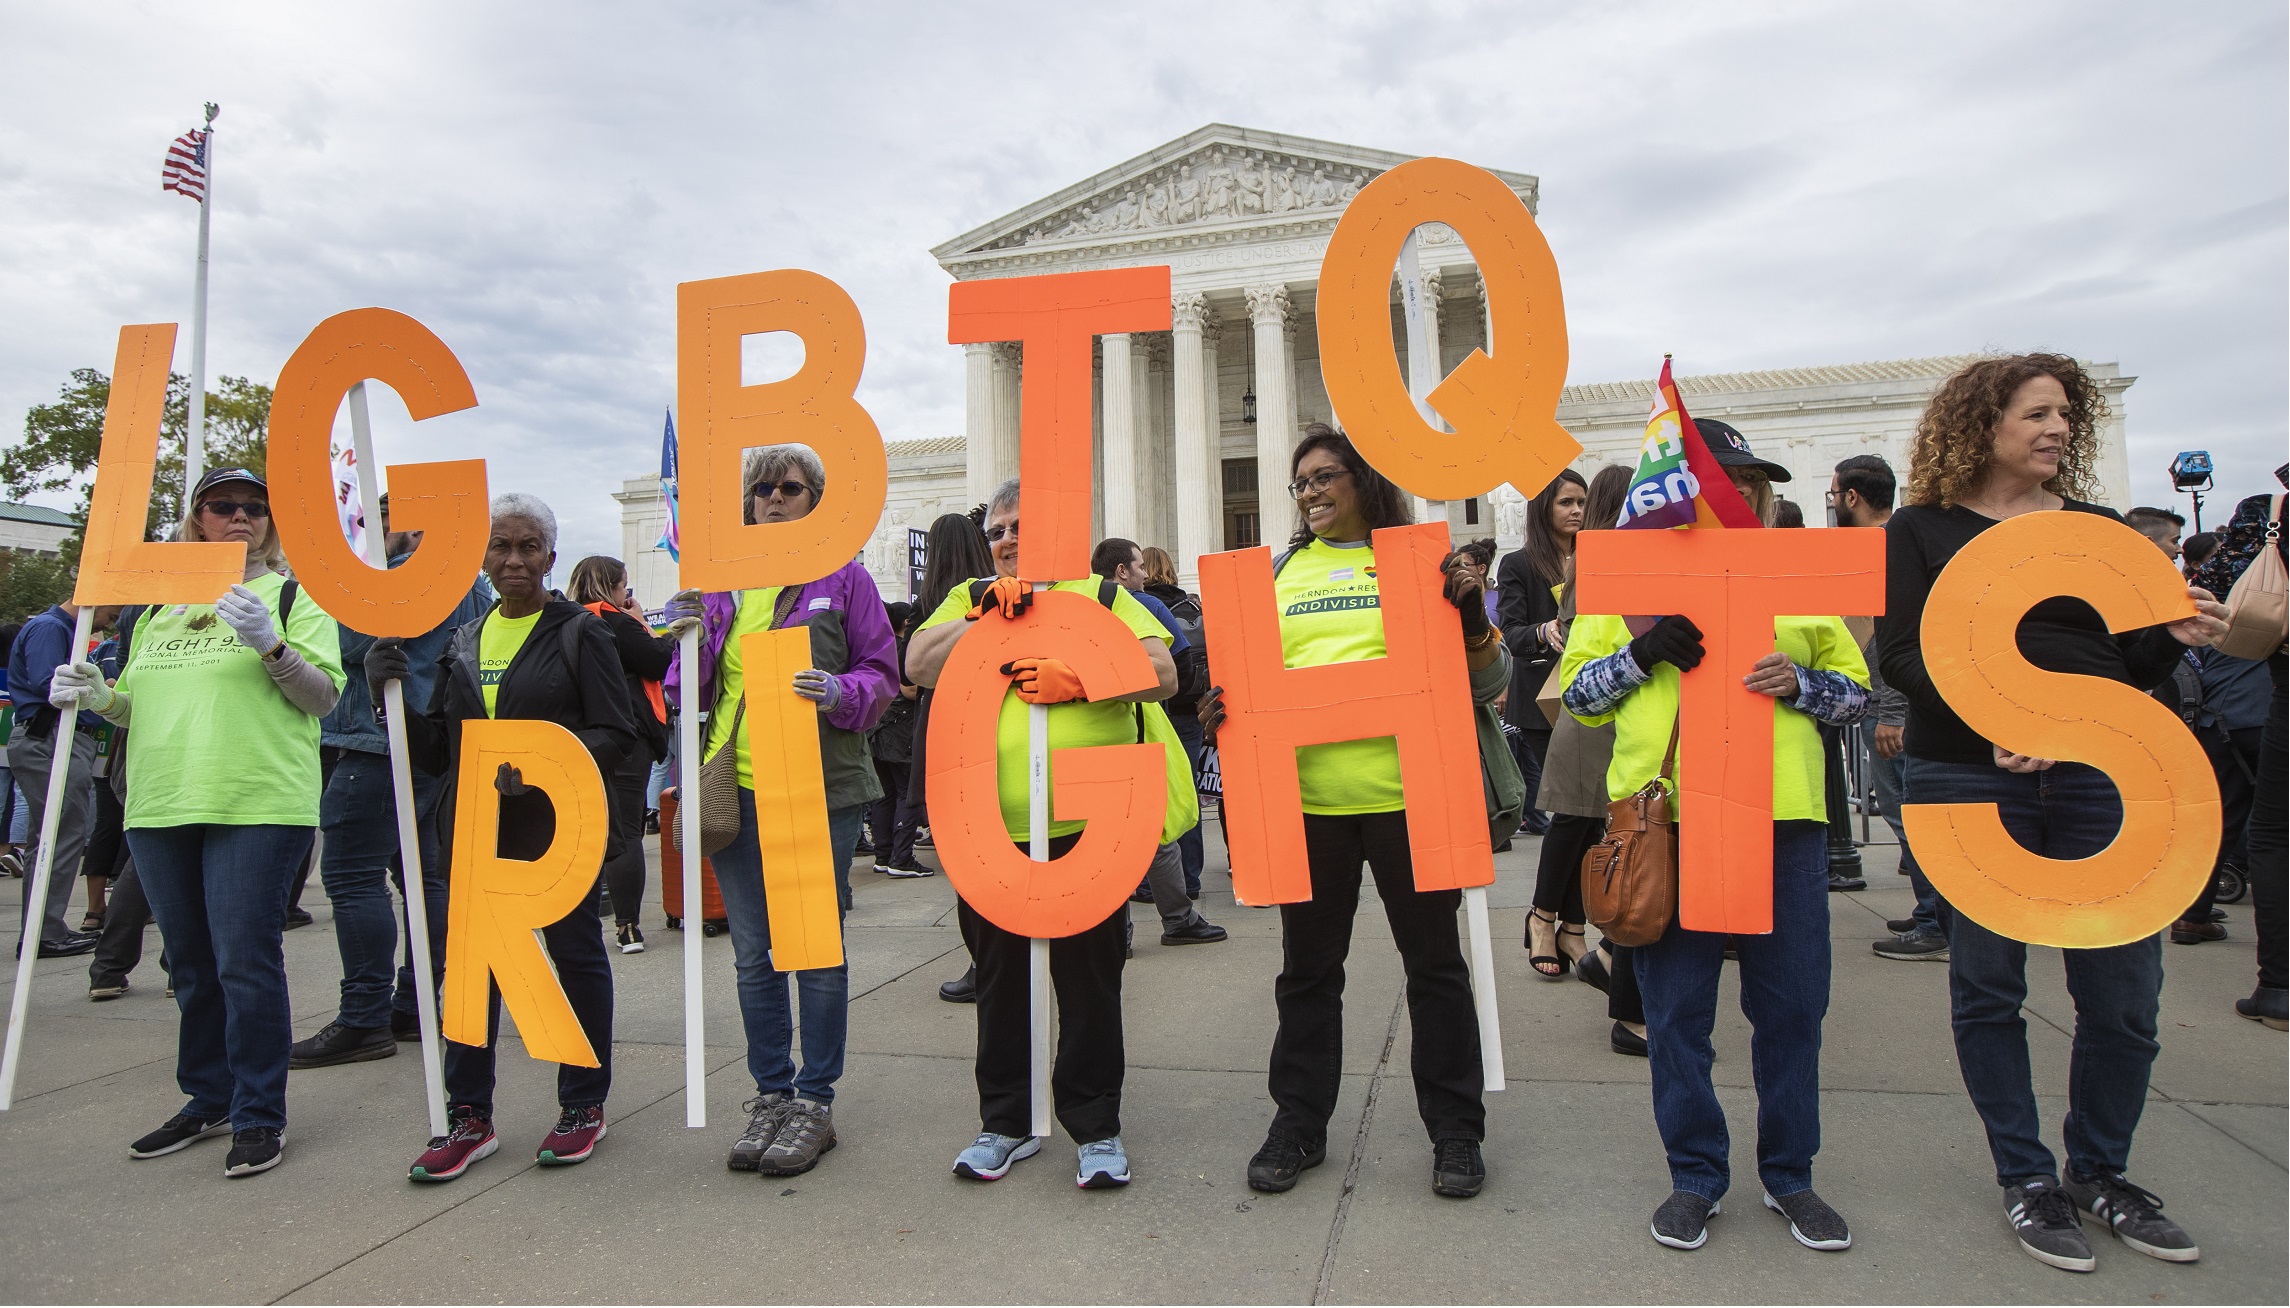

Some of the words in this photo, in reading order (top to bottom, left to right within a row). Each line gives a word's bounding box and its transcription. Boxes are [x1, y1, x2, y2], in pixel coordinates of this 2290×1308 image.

[1174, 254, 1234, 269] JUSTICE
[1241, 245, 1291, 261] UNDER
[1294, 587, 1346, 600] HERNDON
[1357, 584, 1378, 592] RES
[1290, 597, 1377, 613] INDIVISIB
[138, 651, 178, 660] TIONAL
[182, 647, 243, 657] MEMORIAL
[135, 663, 183, 671] SEPTEMBER
[200, 658, 220, 666] 2001
